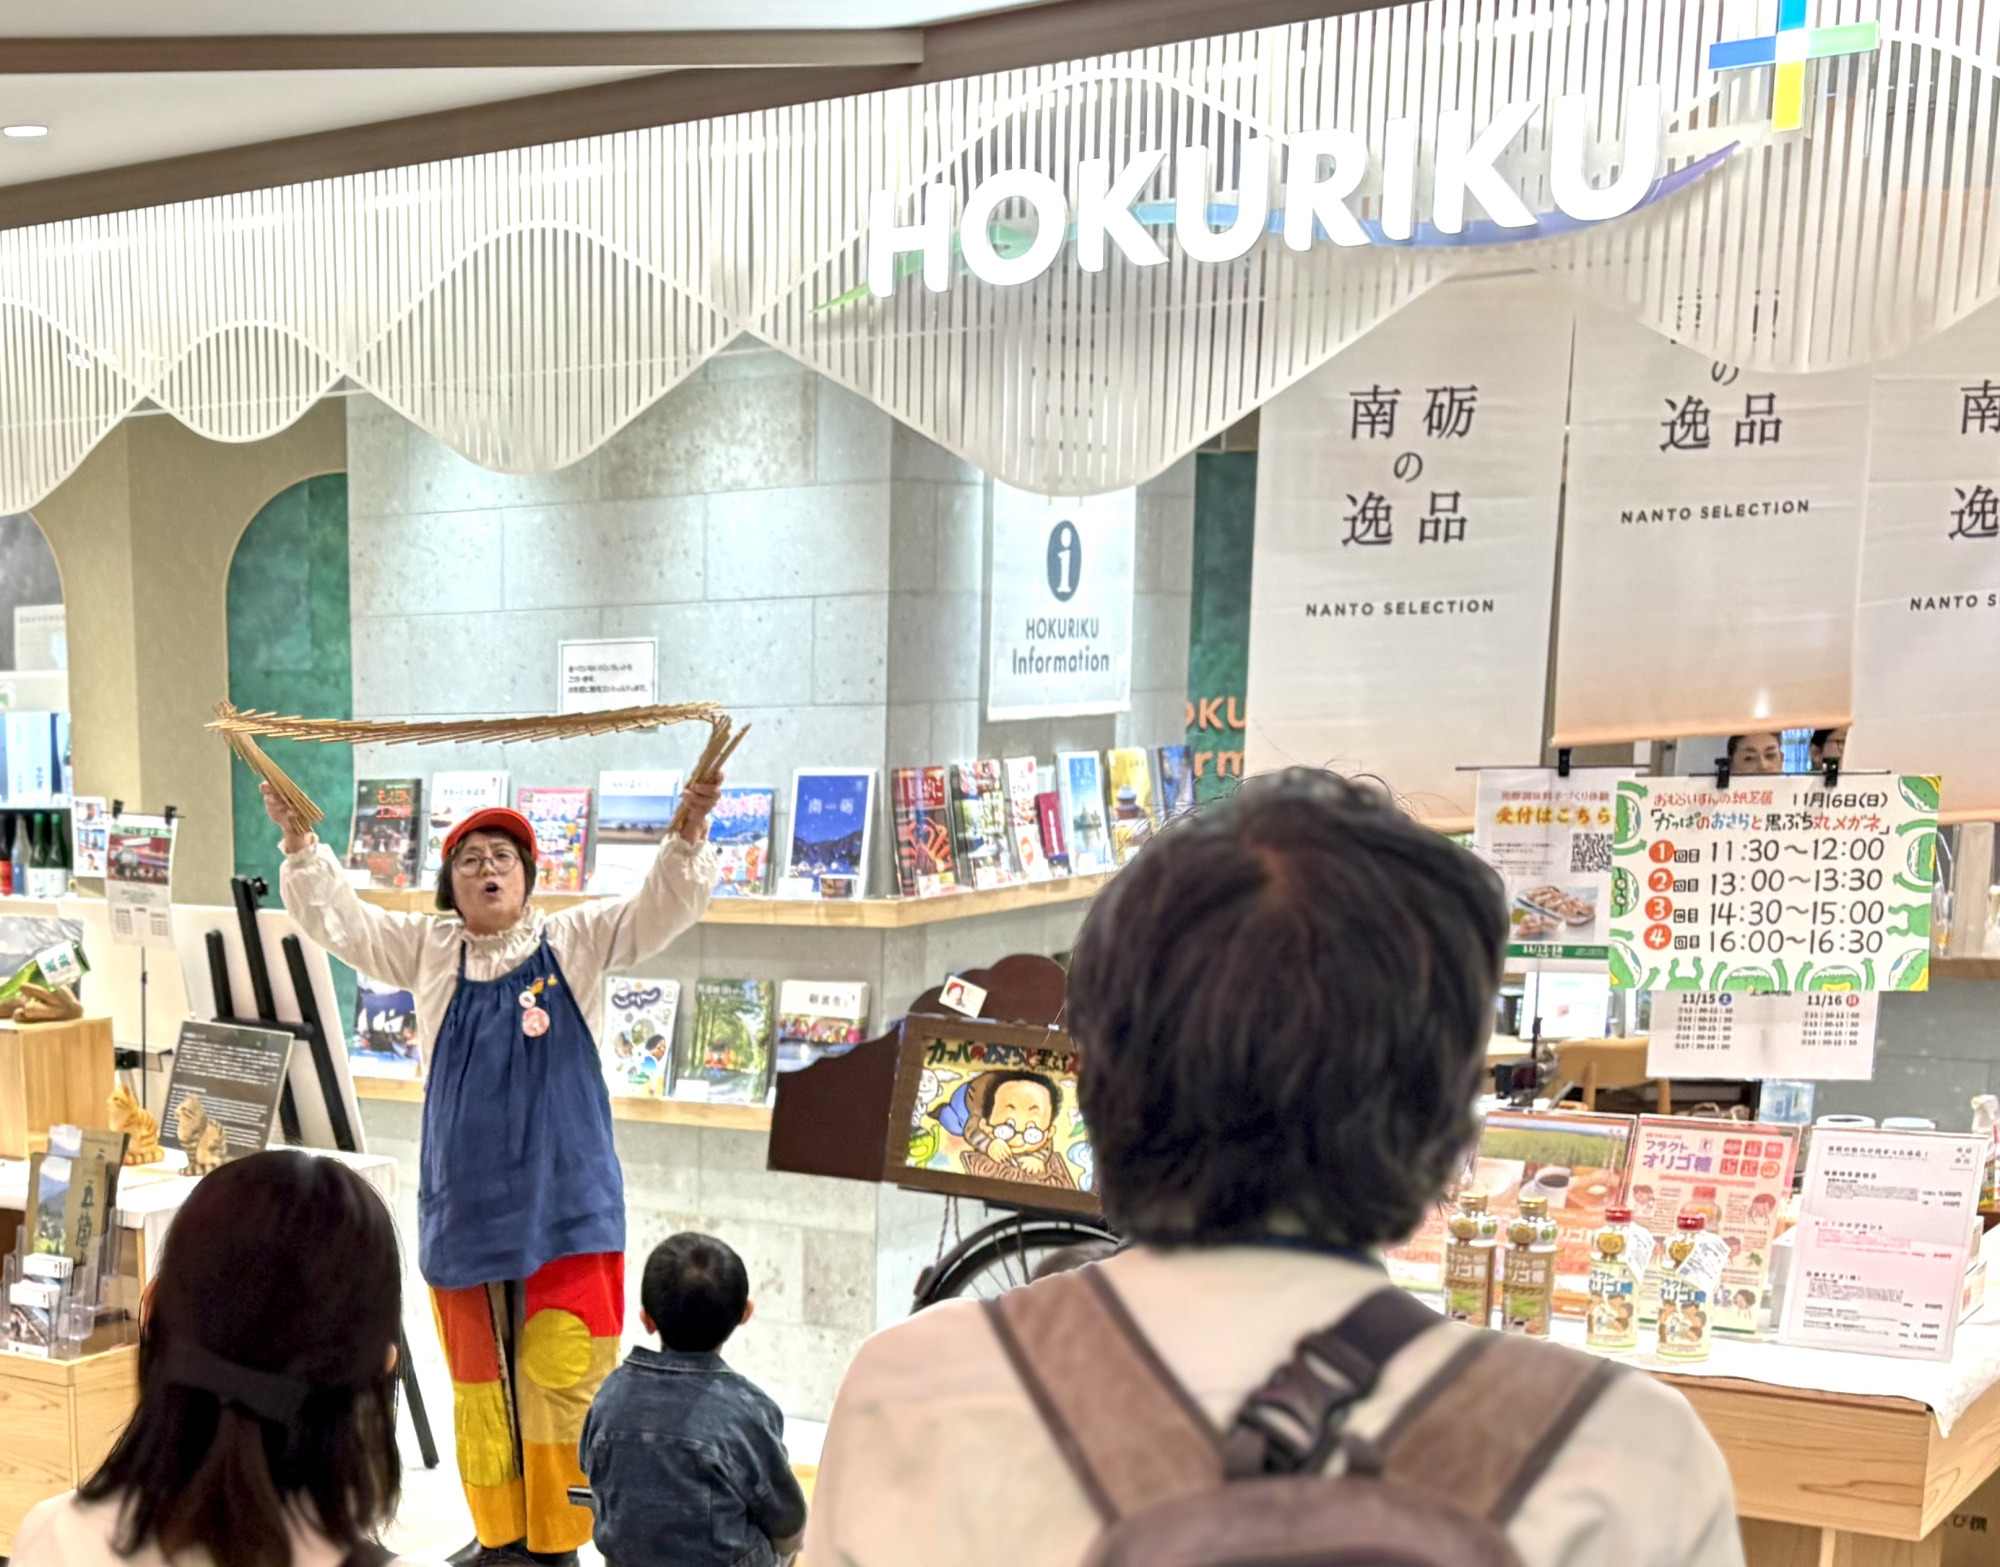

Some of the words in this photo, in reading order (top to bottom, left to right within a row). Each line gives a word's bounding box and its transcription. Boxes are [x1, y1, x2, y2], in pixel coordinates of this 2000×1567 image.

[867, 82, 1663, 298] HOKURIKU
[1350, 384, 1478, 440] 南砺
[1659, 392, 1782, 452] 逸品
[1394, 452, 1423, 482] の
[1341, 491, 1467, 546] 逸品
[1621, 507, 1691, 523] NANTO
[1700, 499, 1809, 519] SELECTION
[1306, 603, 1374, 617] NANTO
[1384, 600, 1494, 615] SELECTION
[1910, 594, 1978, 611] NANTO
[1026, 618, 1099, 640] HOKURIKU
[1012, 646, 1110, 675] Information
[1496, 805, 1612, 826] 受付はこちら
[1682, 992, 1716, 1005] 11/15
[1807, 994, 1842, 1008] 11/16
[1645, 1139, 1689, 1154] フラクト
